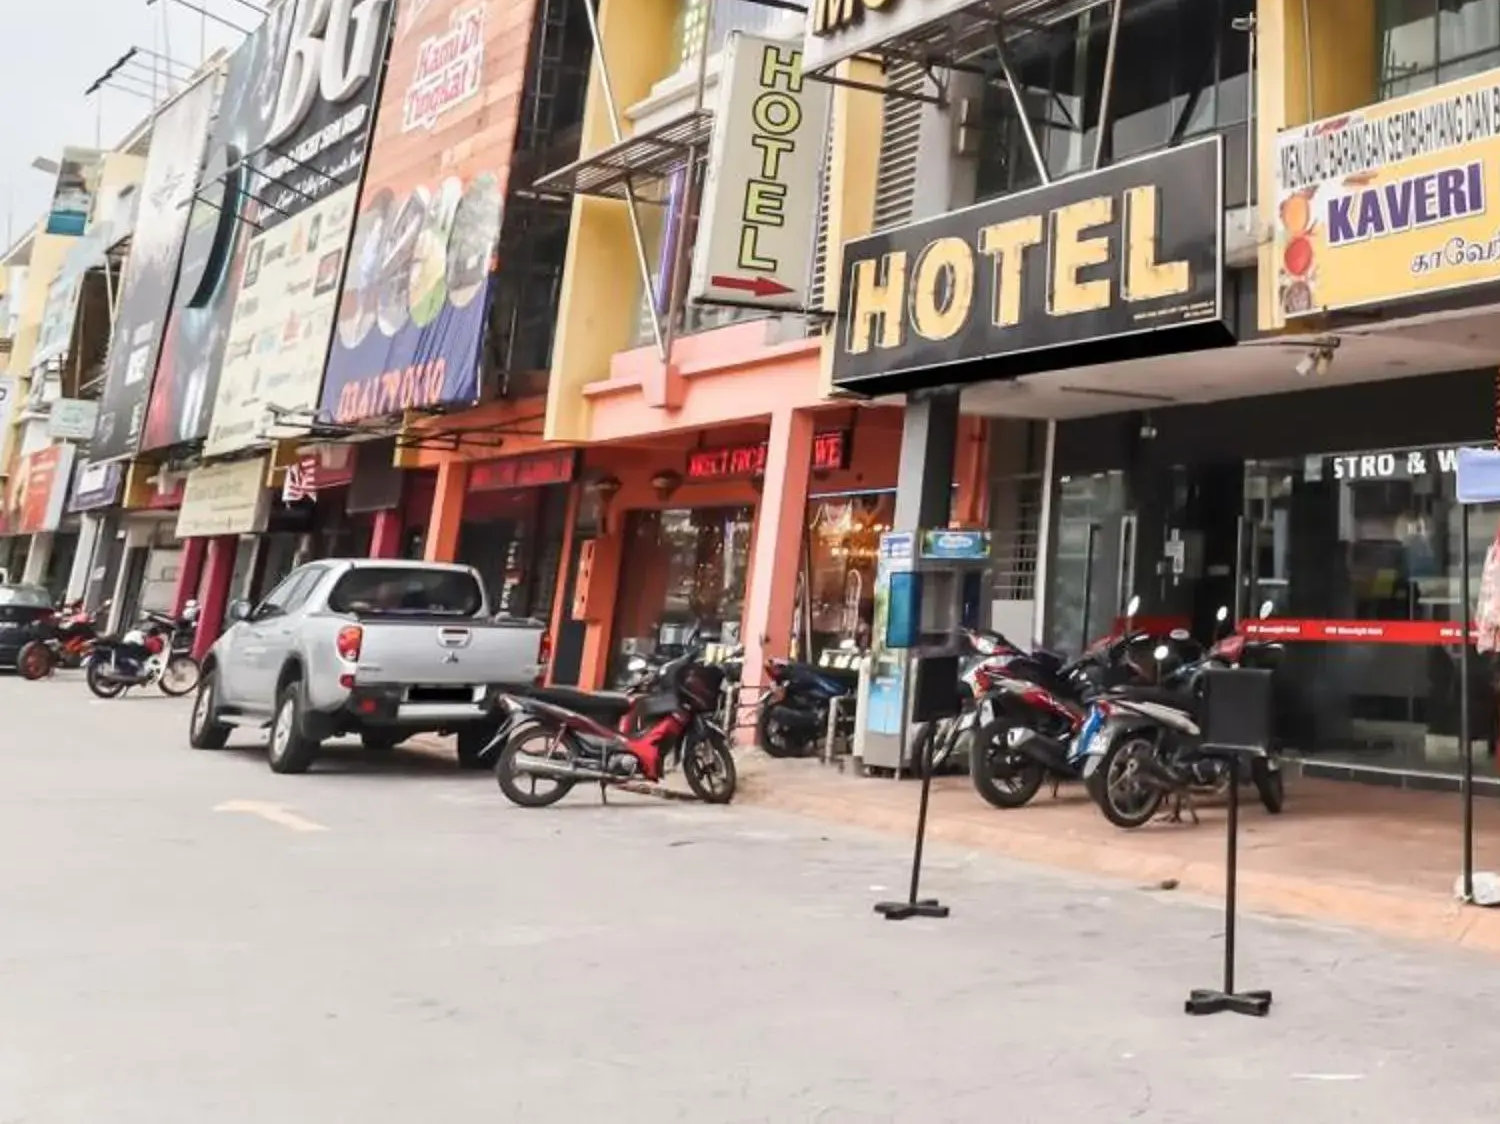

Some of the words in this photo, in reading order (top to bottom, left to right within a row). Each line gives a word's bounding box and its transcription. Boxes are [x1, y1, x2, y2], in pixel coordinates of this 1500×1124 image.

[738, 46, 803, 272] HOTEL
[1328, 119, 1386, 177] BARANGAN
[1388, 95, 1462, 160] SEMBAHYANG
[1466, 88, 1490, 142] DAN
[1328, 162, 1483, 243] KAVERI
[845, 184, 1190, 355] HOTEL
[1407, 451, 1427, 474] &
